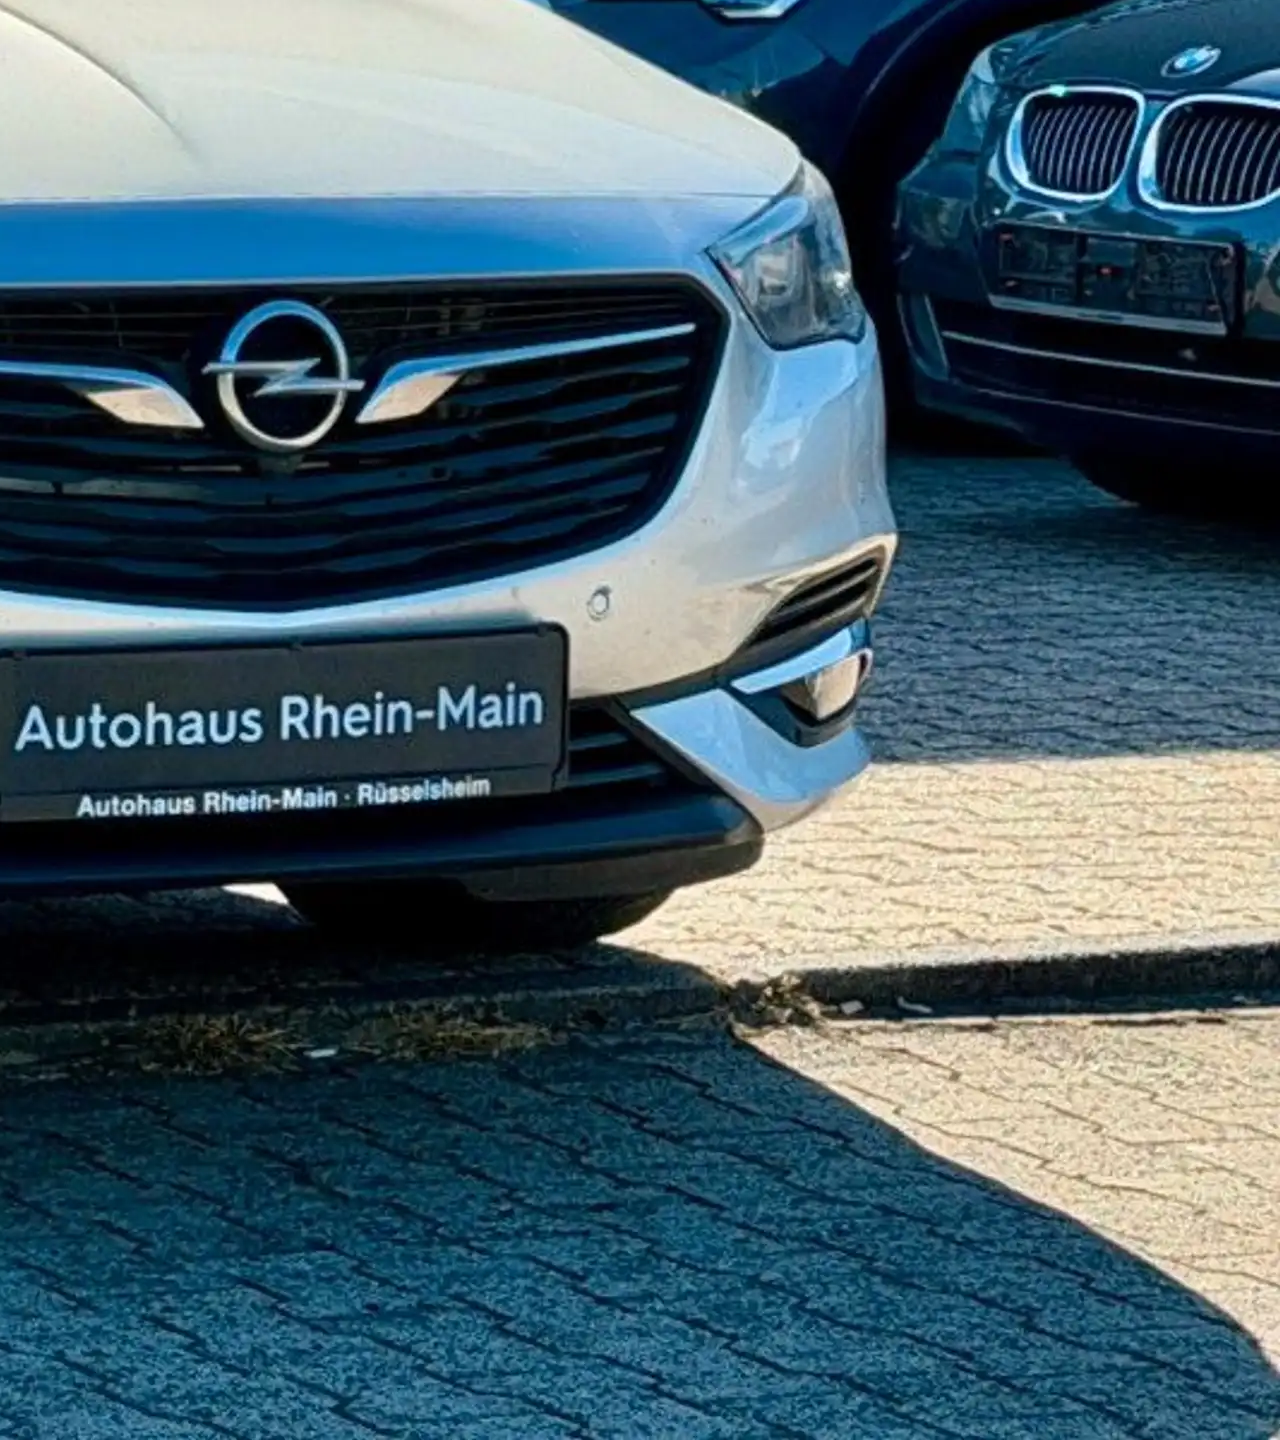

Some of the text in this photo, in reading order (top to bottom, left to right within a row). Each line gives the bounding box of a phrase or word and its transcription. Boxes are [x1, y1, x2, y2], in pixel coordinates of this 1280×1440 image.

[14, 682, 544, 751] Autohaus Rhein-Main
[76, 774, 492, 818] Autohaus Rhein-Main Rüsselsheim
